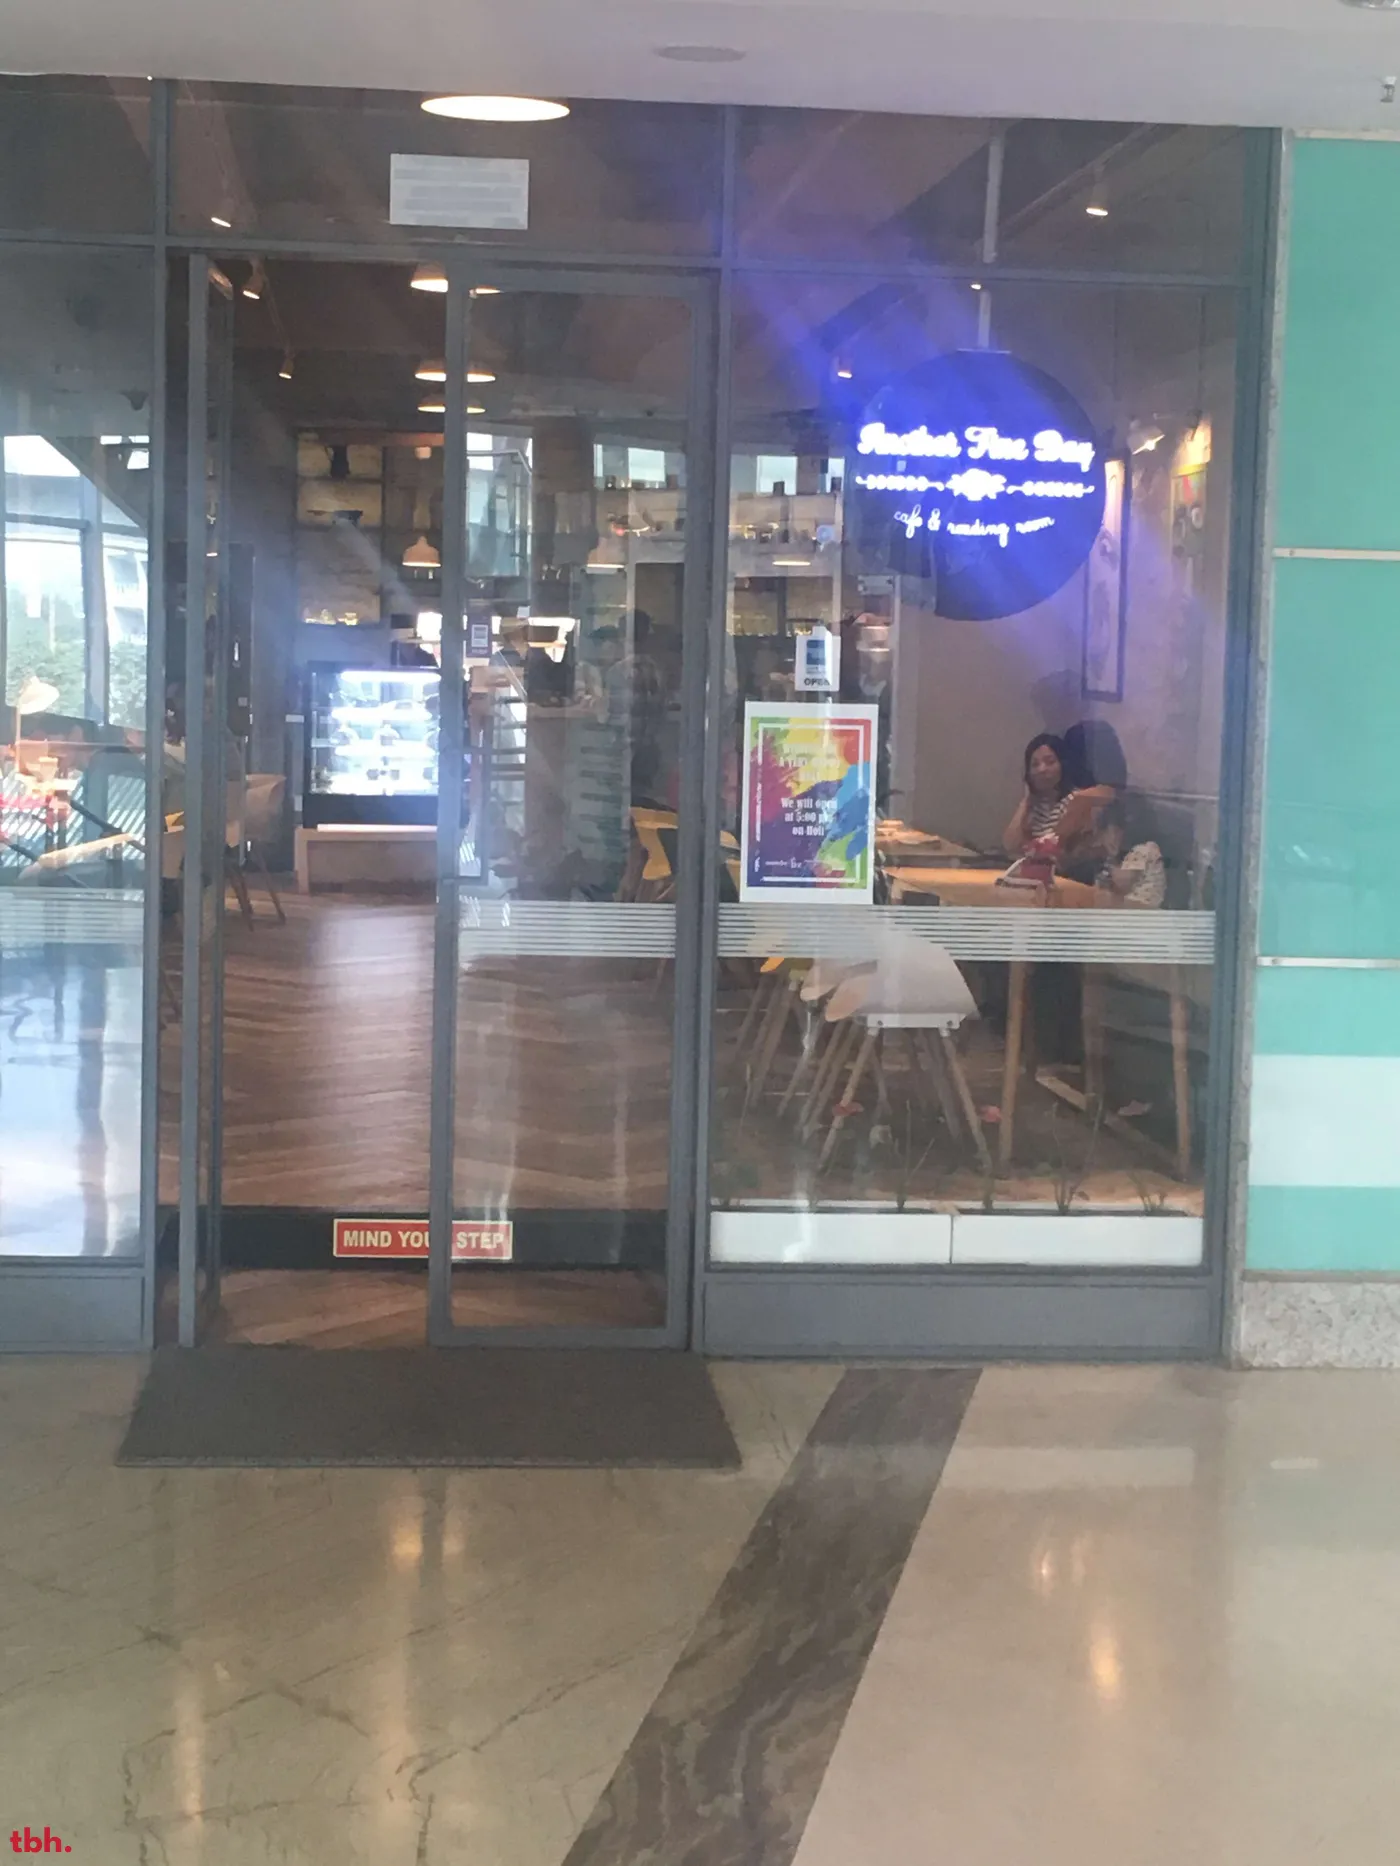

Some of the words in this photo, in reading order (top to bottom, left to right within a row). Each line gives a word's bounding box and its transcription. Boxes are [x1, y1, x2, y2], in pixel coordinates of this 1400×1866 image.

[965, 427, 1029, 460] Fine
[1033, 429, 1095, 473] Day
[928, 508, 941, 531] &
[804, 677, 831, 687] OPEN
[781, 797, 794, 809] We
[796, 798, 814, 809] will
[815, 798, 838, 810] open
[784, 812, 794, 822] at
[796, 811, 817, 823] 5:00
[792, 826, 804, 836] on
[806, 825, 825, 837] Holi
[343, 1230, 392, 1248] MIND
[397, 1230, 429, 1248] YO
[456, 1231, 505, 1249] STEP
